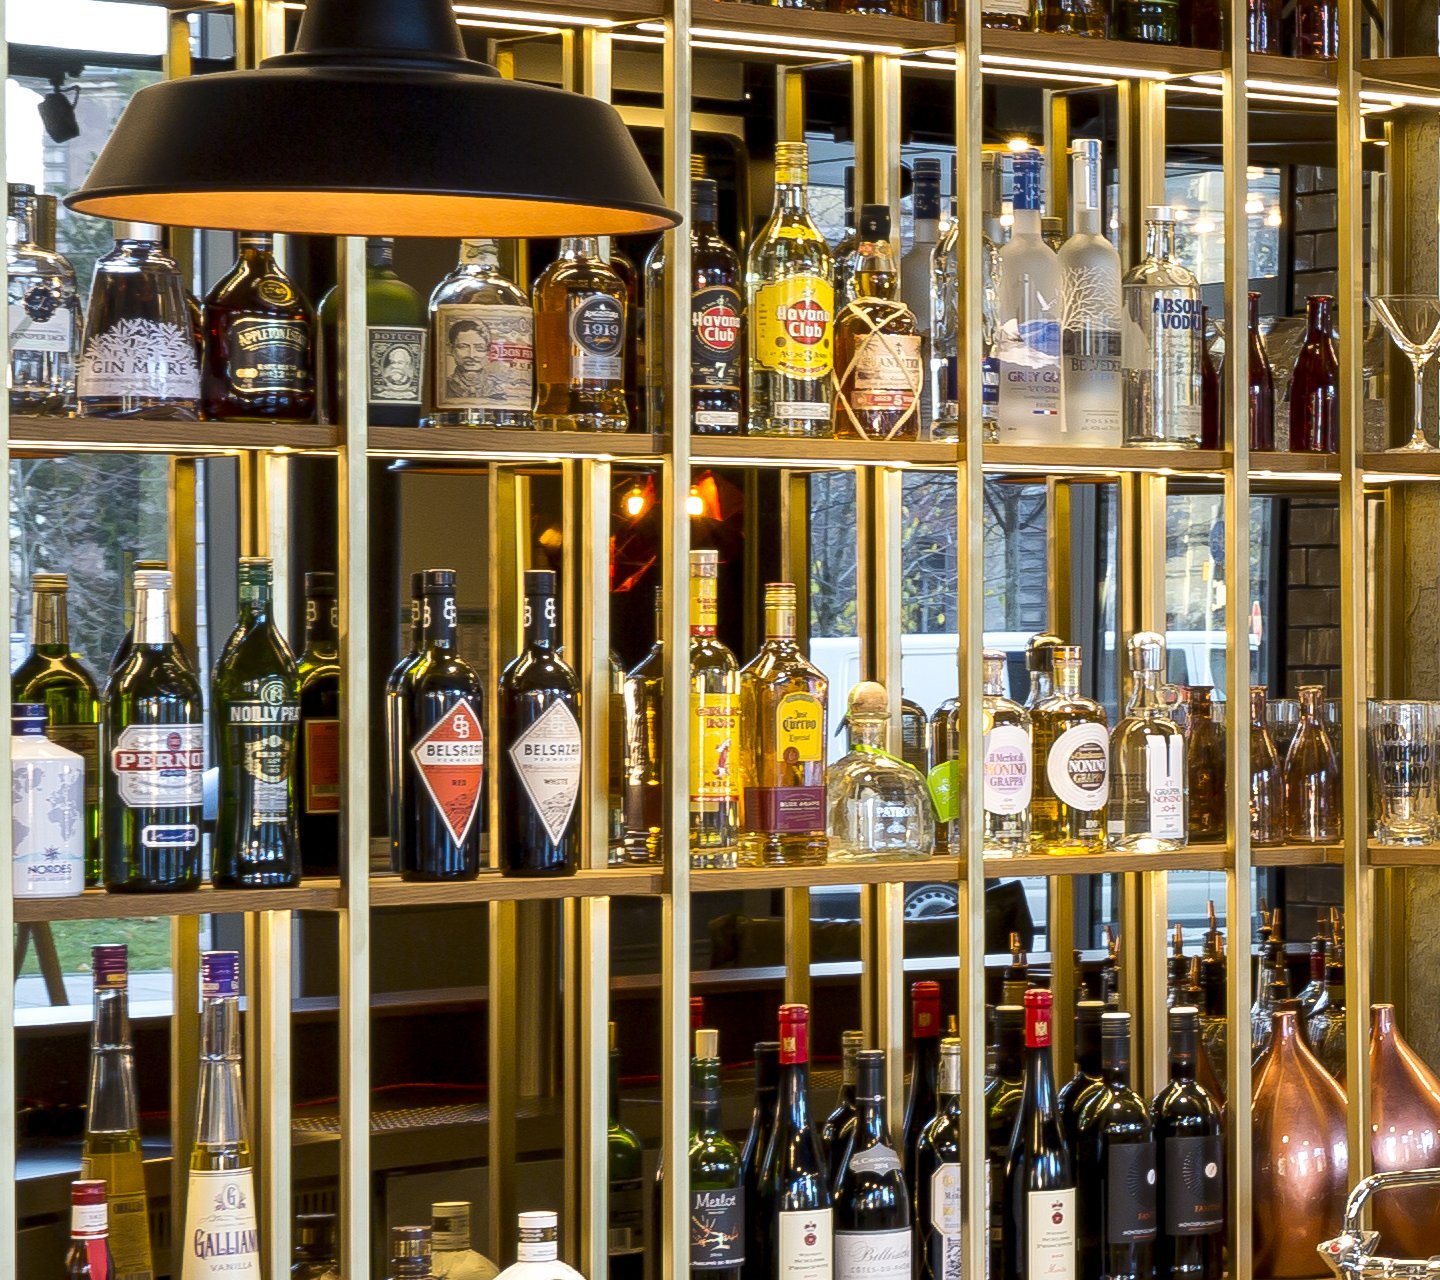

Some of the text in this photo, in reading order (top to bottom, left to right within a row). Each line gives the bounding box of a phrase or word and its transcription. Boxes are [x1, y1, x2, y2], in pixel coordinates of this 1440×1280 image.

[693, 311, 740, 327] Havana
[776, 304, 831, 322] Havana
[583, 322, 619, 336] 1919
[704, 328, 734, 342] Club
[788, 321, 823, 338] Club
[91, 361, 126, 375] GIN
[714, 362, 727, 378] 7
[893, 394, 903, 406] 5
[230, 705, 280, 722] NOILLY
[782, 719, 817, 733] Cuervo
[1068, 760, 1106, 772] NONINO
[990, 776, 1024, 787] GRAPPA
[694, 1193, 736, 1210] Merlot
[209, 1262, 252, 1272] VANILLA
